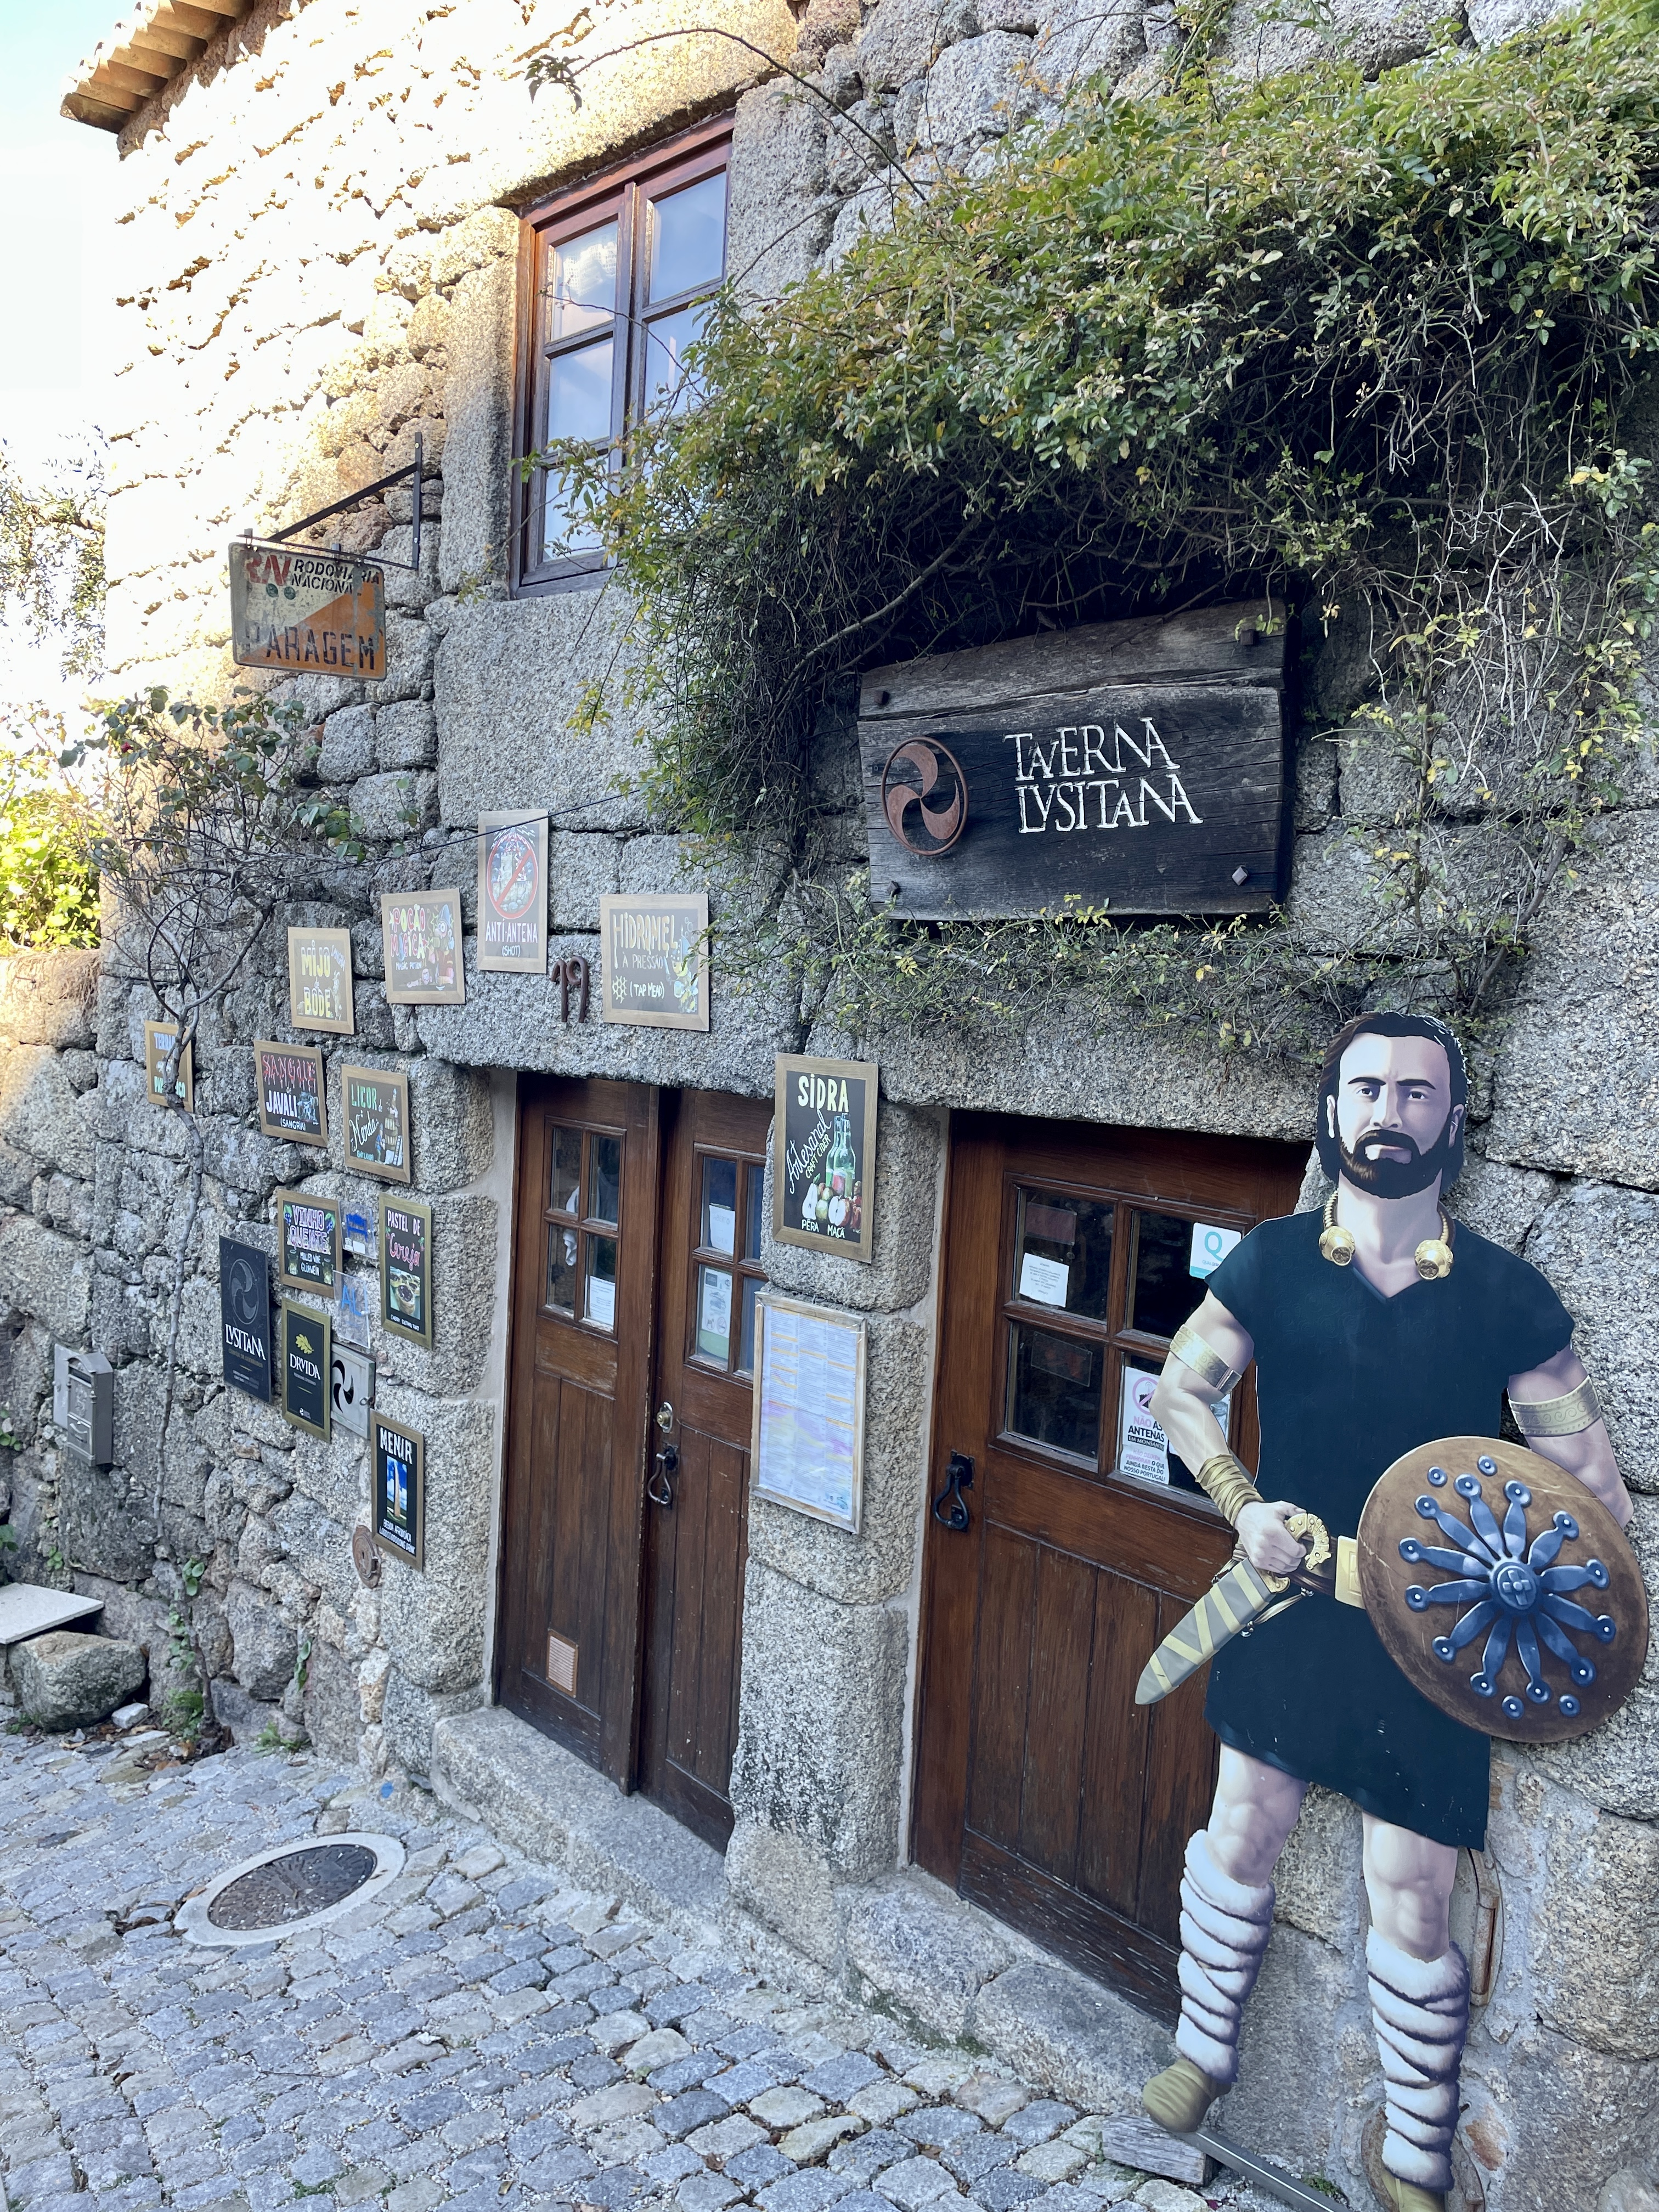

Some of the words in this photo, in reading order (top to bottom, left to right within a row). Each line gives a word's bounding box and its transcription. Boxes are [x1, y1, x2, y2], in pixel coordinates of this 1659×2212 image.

[291, 573, 362, 596] NACIONA
[1003, 716, 1181, 782] TAVERNA
[392, 904, 426, 934] POÇÃO
[612, 912, 678, 961] HIDROMEL
[301, 939, 331, 978] MIJO
[501, 944, 521, 957] (SHOT)
[632, 953, 663, 969] PRESSÃO
[303, 986, 331, 1018] BODE
[551, 956, 590, 1023] 19
[647, 981, 665, 999] MEAD)
[154, 1032, 176, 1051] TERRA
[263, 1054, 316, 1090] SANGUE
[266, 1090, 298, 1118] JAVALI
[351, 1081, 377, 1111] LICOR
[798, 1073, 849, 1113] SIDRA
[280, 1117, 306, 1131] (SANGRIA)
[786, 1109, 832, 1194] Artesanal
[805, 1153, 819, 1179] CRAFT
[817, 1133, 831, 1157] CIDER
[292, 1205, 324, 1231] VINHO
[387, 1210, 408, 1233] PASTEL
[413, 1217, 420, 1237] DE
[802, 1218, 820, 1233] PÊRA
[827, 1224, 845, 1239] MAÇÃ
[290, 1225, 331, 1255] QUENTE
[389, 1232, 420, 1271] Cereja
[341, 1285, 362, 1316] AL
[290, 1353, 321, 1380] DRVIDA
[1128, 1425, 1165, 1442] ANTENAS
[1133, 1415, 1152, 1427] NÃO
[380, 1427, 413, 1465] MENIR
[1137, 1438, 1164, 1450] MONSANTO
[1126, 1453, 1151, 1464] PENHORAR
[1126, 1460, 1141, 1468] AINDA
[1142, 1464, 1156, 1472] RESTA
[1124, 1465, 1139, 1474] NOSSO
[1140, 1470, 1166, 1482] PORTUGAL!
